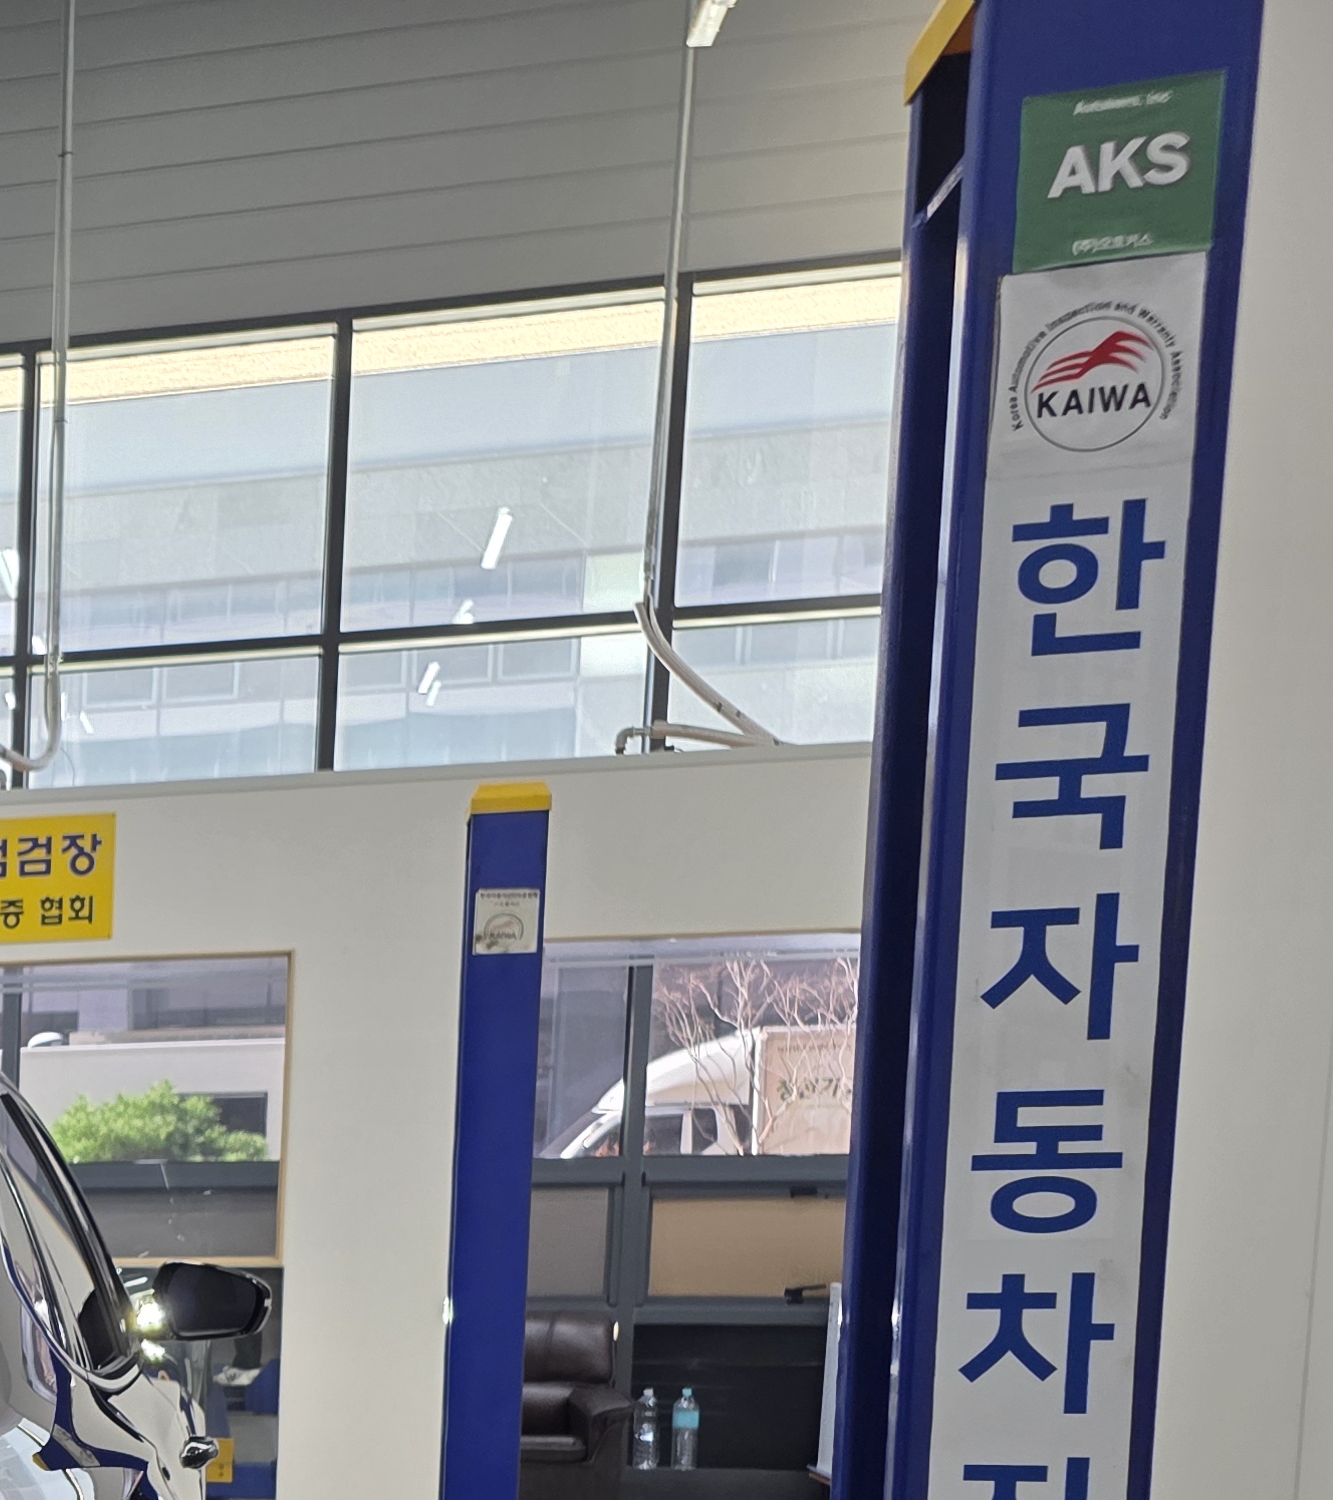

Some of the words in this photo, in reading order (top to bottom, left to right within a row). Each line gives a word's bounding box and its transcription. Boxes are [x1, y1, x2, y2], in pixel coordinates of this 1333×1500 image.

[1047, 131, 1191, 200] AKS
[1114, 302, 1138, 315] and
[1037, 382, 1151, 418] KAIWA
[39, 895, 94, 927] 협회
